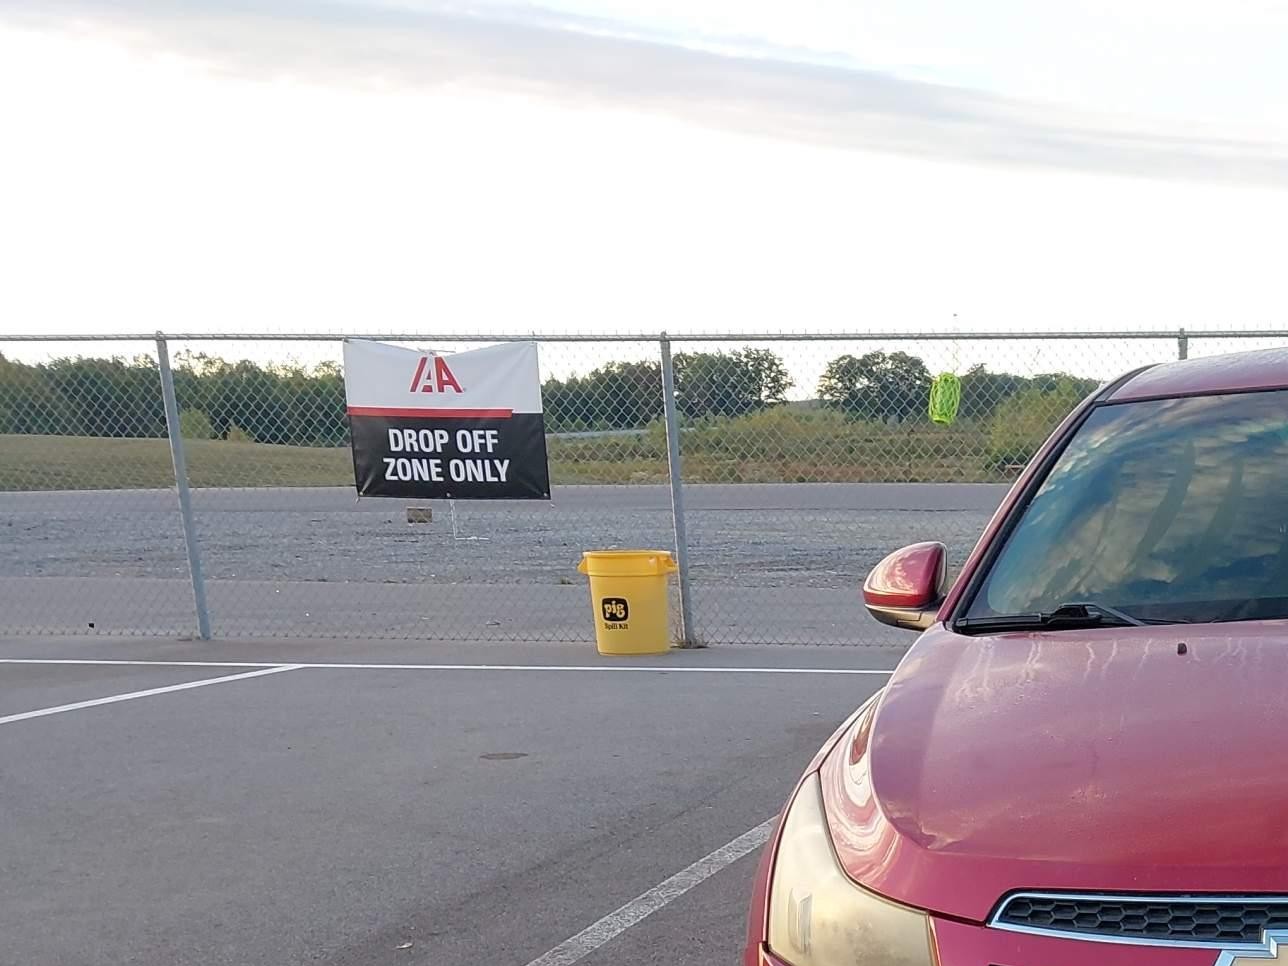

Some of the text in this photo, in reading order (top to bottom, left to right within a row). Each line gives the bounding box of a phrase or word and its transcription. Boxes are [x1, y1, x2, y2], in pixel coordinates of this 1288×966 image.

[388, 428, 499, 453] DROP OFF
[383, 457, 510, 482] ZONE ONLY
